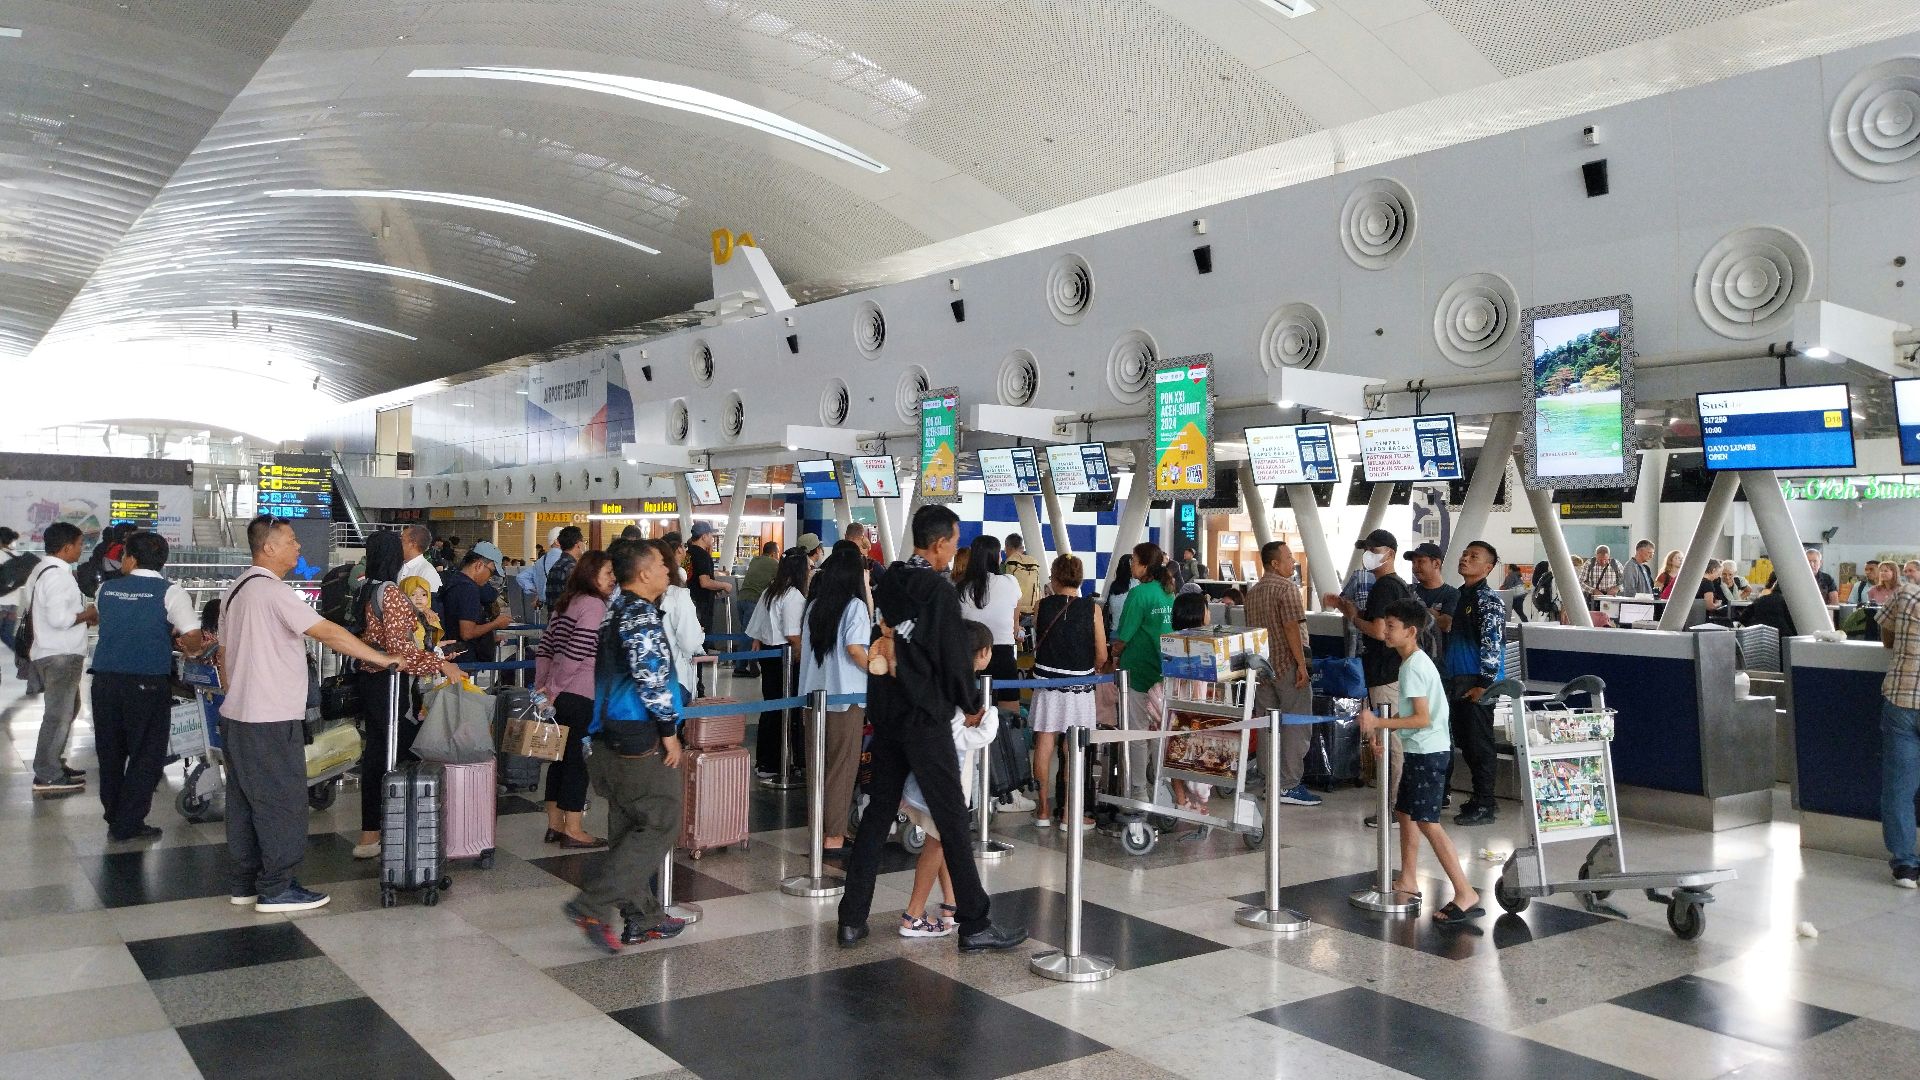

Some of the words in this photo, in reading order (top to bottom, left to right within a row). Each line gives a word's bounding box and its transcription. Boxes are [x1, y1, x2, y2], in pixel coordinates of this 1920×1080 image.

[544, 385, 563, 404] AIRPORT
[564, 379, 589, 400] SECURITY
[1160, 392, 1173, 405] PON
[1174, 390, 1185, 403] XXI
[1160, 402, 1201, 418] ACEH-SUMUT
[1702, 400, 1728, 410] Susi
[1160, 417, 1177, 431] 2024
